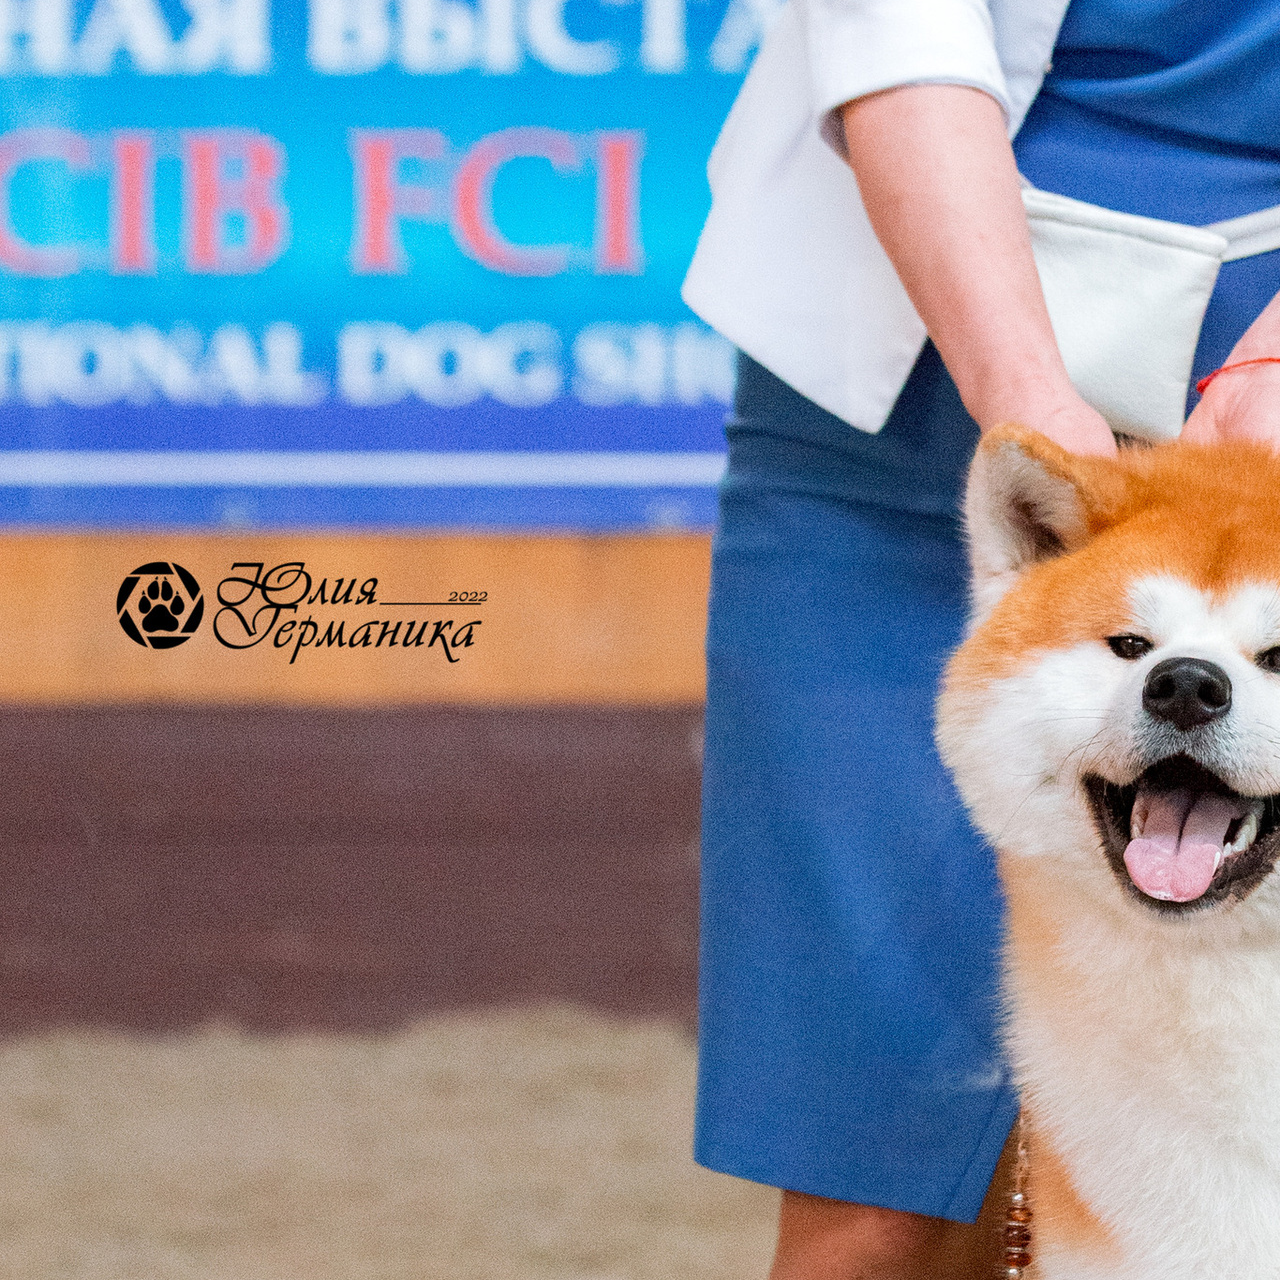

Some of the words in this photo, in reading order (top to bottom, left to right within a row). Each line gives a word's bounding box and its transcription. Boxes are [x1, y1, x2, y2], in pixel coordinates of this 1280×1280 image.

[0, 127, 290, 277] CIB
[350, 127, 645, 277] FCI
[338, 323, 566, 407] DOG
